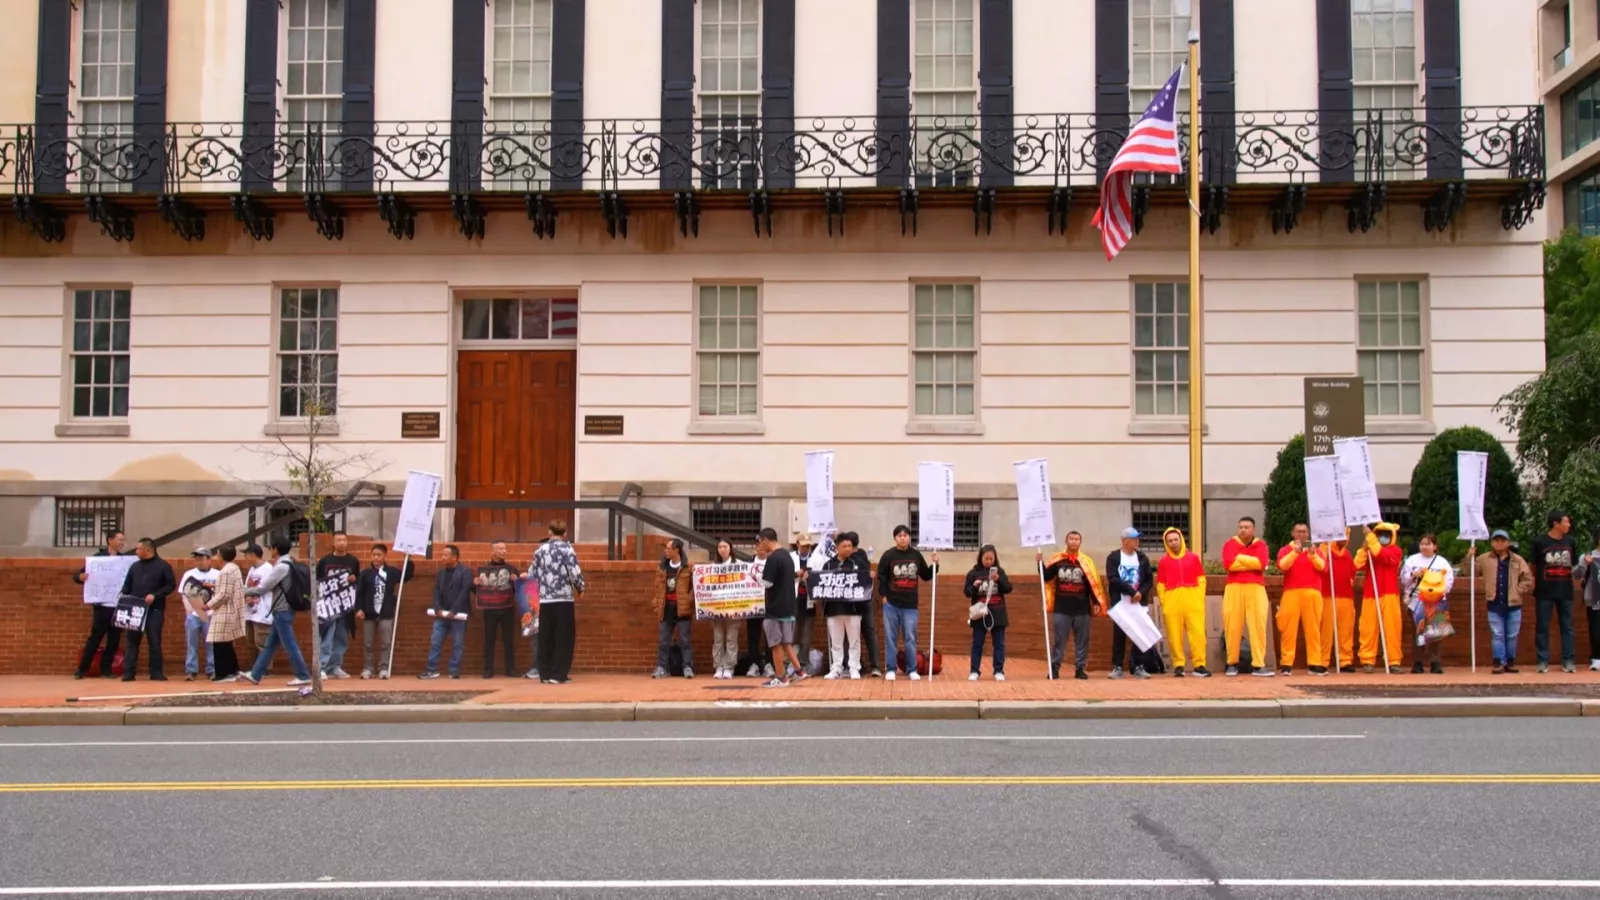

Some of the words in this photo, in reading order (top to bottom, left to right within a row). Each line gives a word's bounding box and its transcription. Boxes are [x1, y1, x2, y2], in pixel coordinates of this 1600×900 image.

[1312, 425, 1328, 433] 600
[1313, 435, 1331, 443] 17th
[1313, 445, 1329, 453] NW
[818, 572, 859, 587] 习近平
[812, 585, 865, 599] 我是你爸爸
